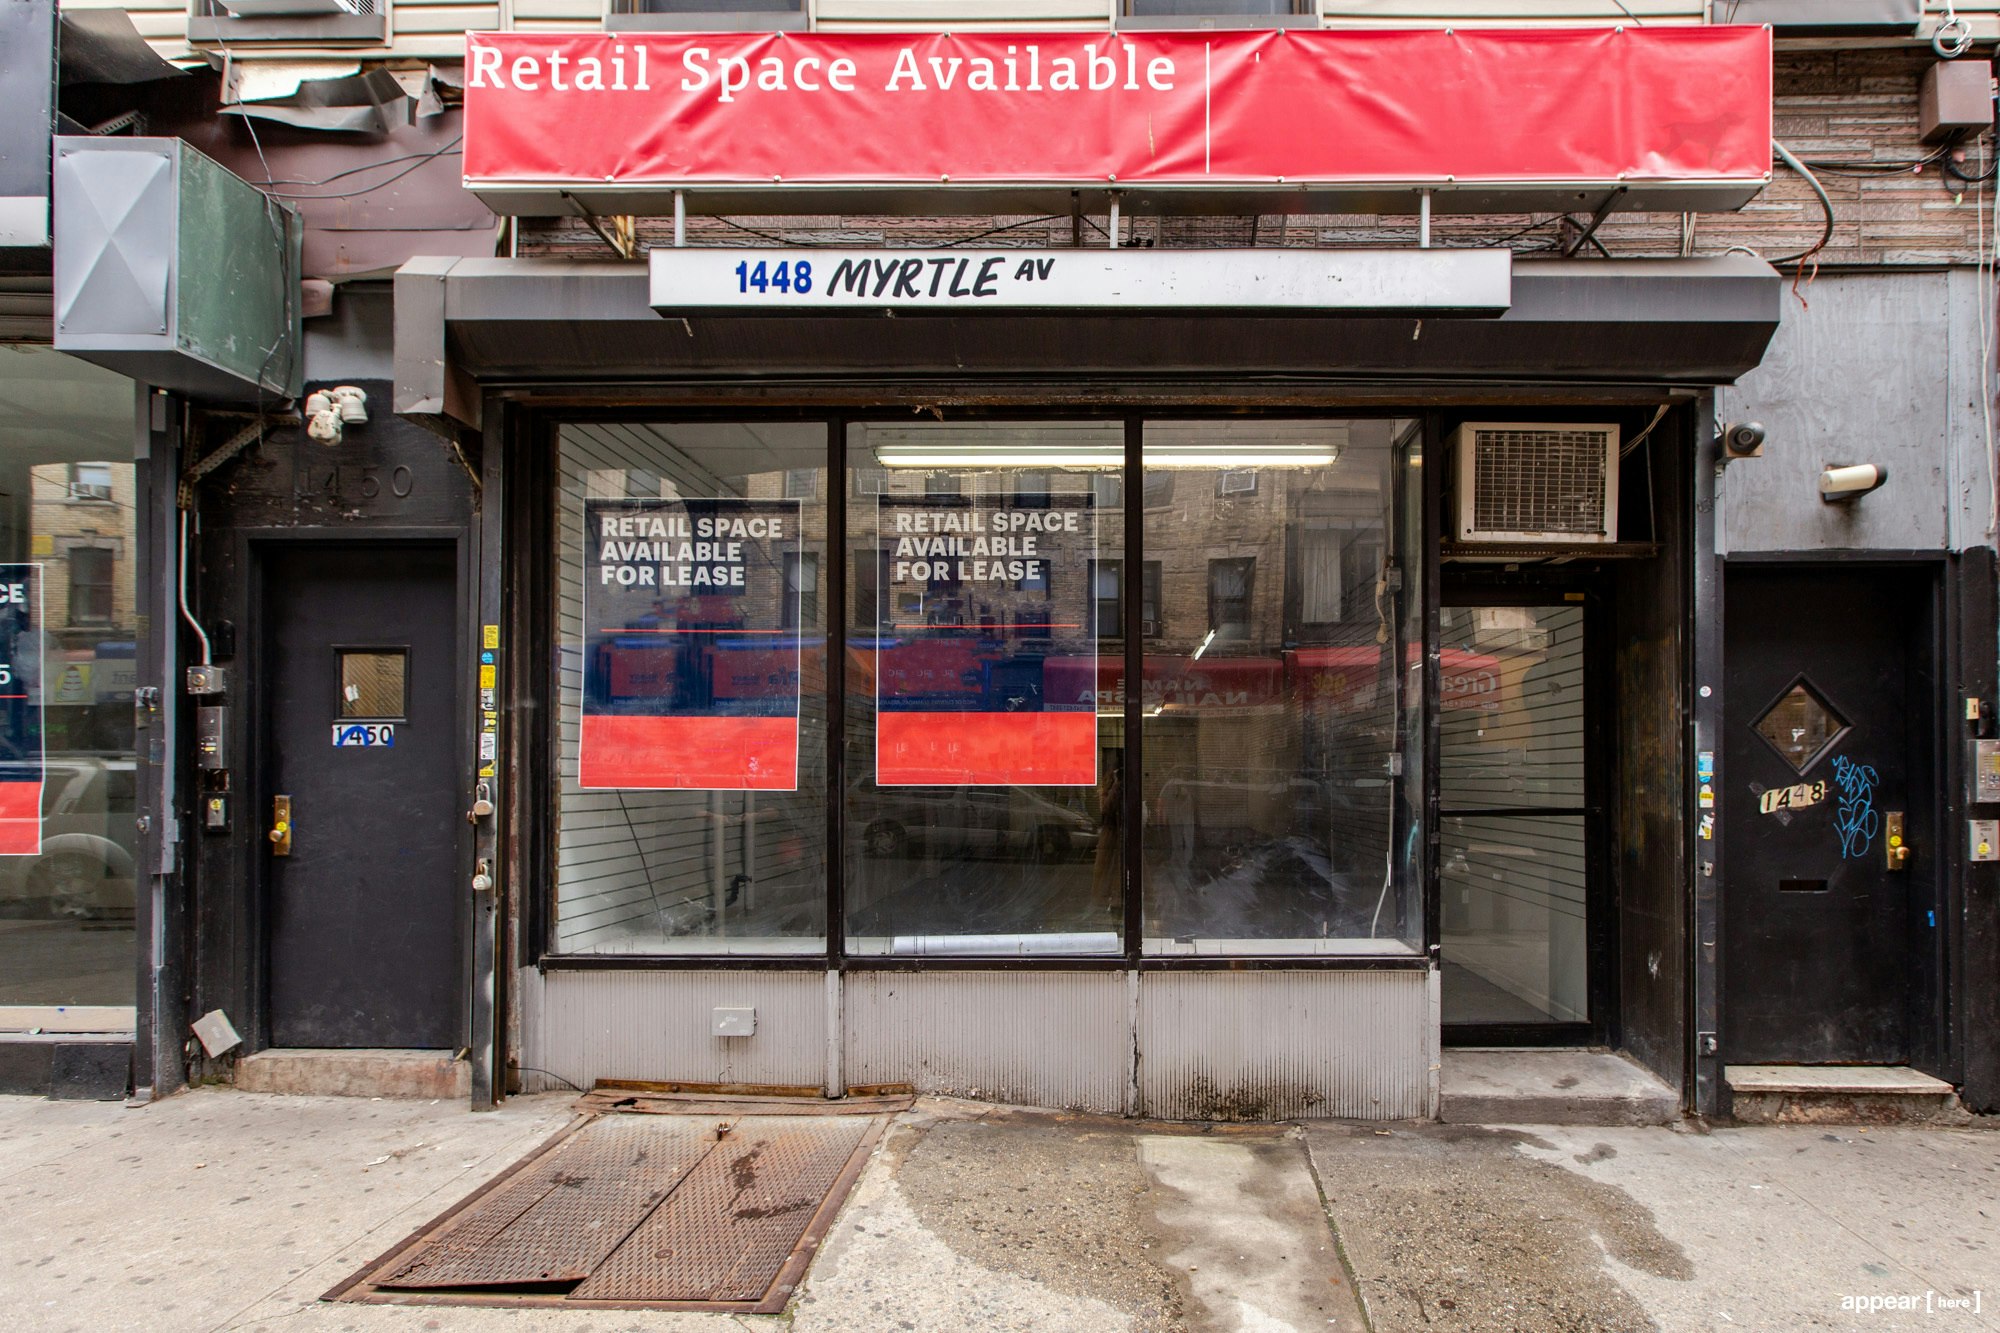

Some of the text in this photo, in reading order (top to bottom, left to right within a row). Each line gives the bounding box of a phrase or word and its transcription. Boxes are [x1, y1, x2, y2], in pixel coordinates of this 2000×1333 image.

[469, 43, 1176, 103] Retail Space Available
[735, 256, 1056, 298] 1448 MYRTLE AV
[602, 517, 783, 538] RETAIL SPACE
[896, 511, 1079, 532] RETAIL SPACE
[600, 541, 742, 562] AVAILABLE
[895, 536, 1037, 557] AVAILABLE
[601, 566, 745, 586] FOR LEASE
[896, 560, 1041, 581] FOR LEASE
[335, 726, 393, 745] 1450
[1764, 782, 1824, 812] 1448
